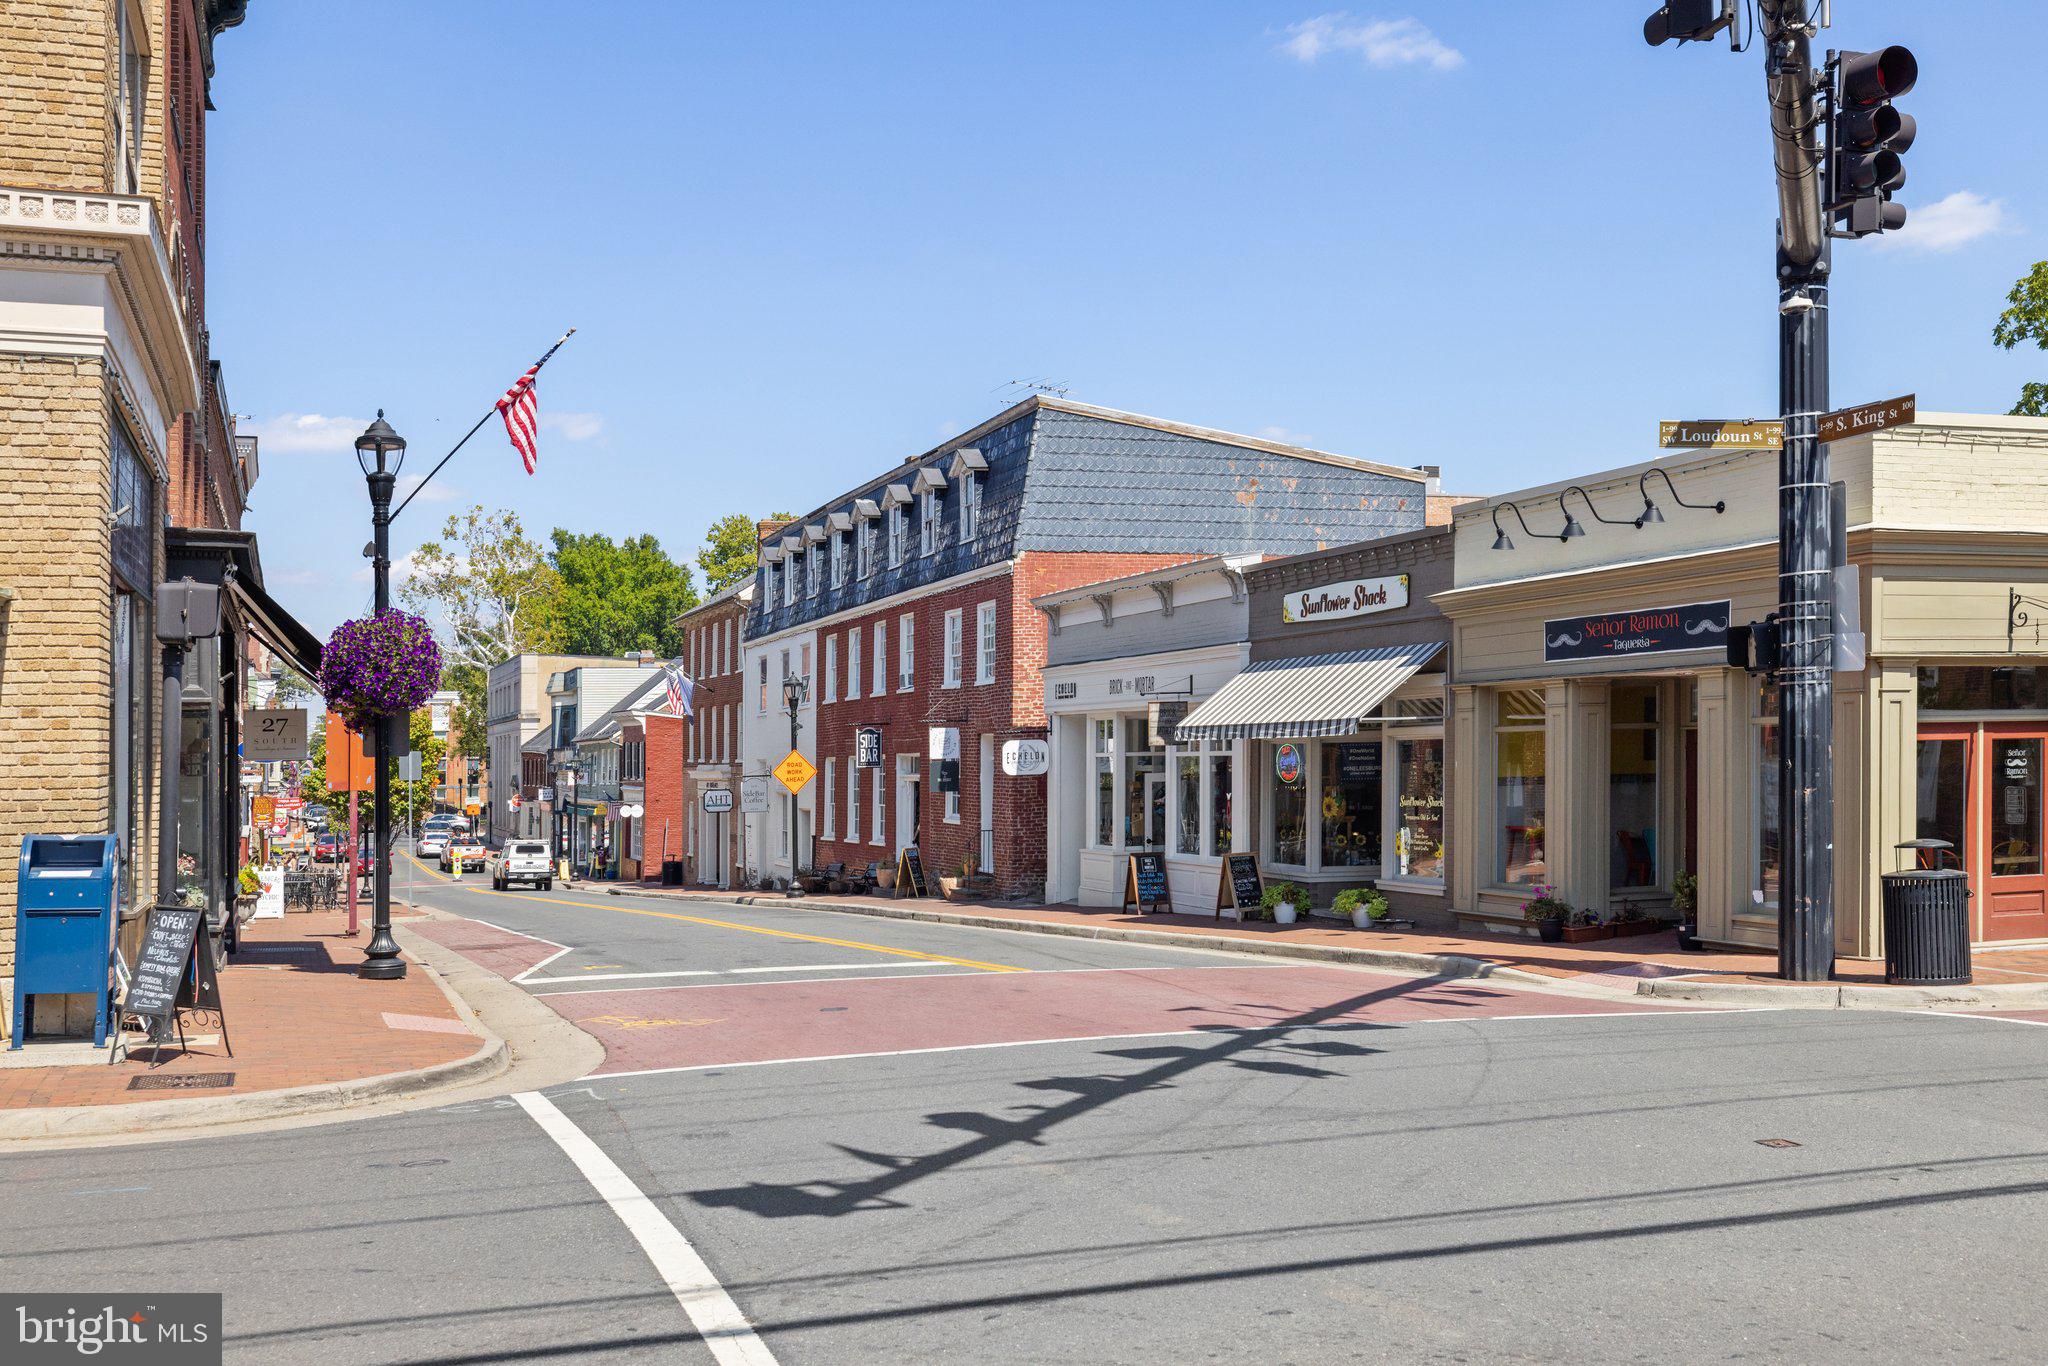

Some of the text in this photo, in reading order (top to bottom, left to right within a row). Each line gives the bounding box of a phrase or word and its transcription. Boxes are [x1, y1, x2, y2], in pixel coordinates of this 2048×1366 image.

[1820, 400, 1914, 431] 1-99 S. King St 100
[1681, 428, 1763, 443] Loudoun St
[1767, 437, 1779, 445] SE
[1300, 584, 1387, 618] Sunflower Shack
[1585, 609, 1680, 638] Señor Ramon
[1109, 679, 1124, 695] BRICK
[1135, 676, 1154, 693] MORTAR
[262, 718, 289, 736] 27
[860, 734, 878, 748] SIDE
[860, 749, 878, 762] BAR
[1006, 752, 1045, 764] ECHELON
[707, 795, 730, 804] AHT
[1400, 794, 1426, 807] Sunflower
[160, 916, 186, 929] OPEN
